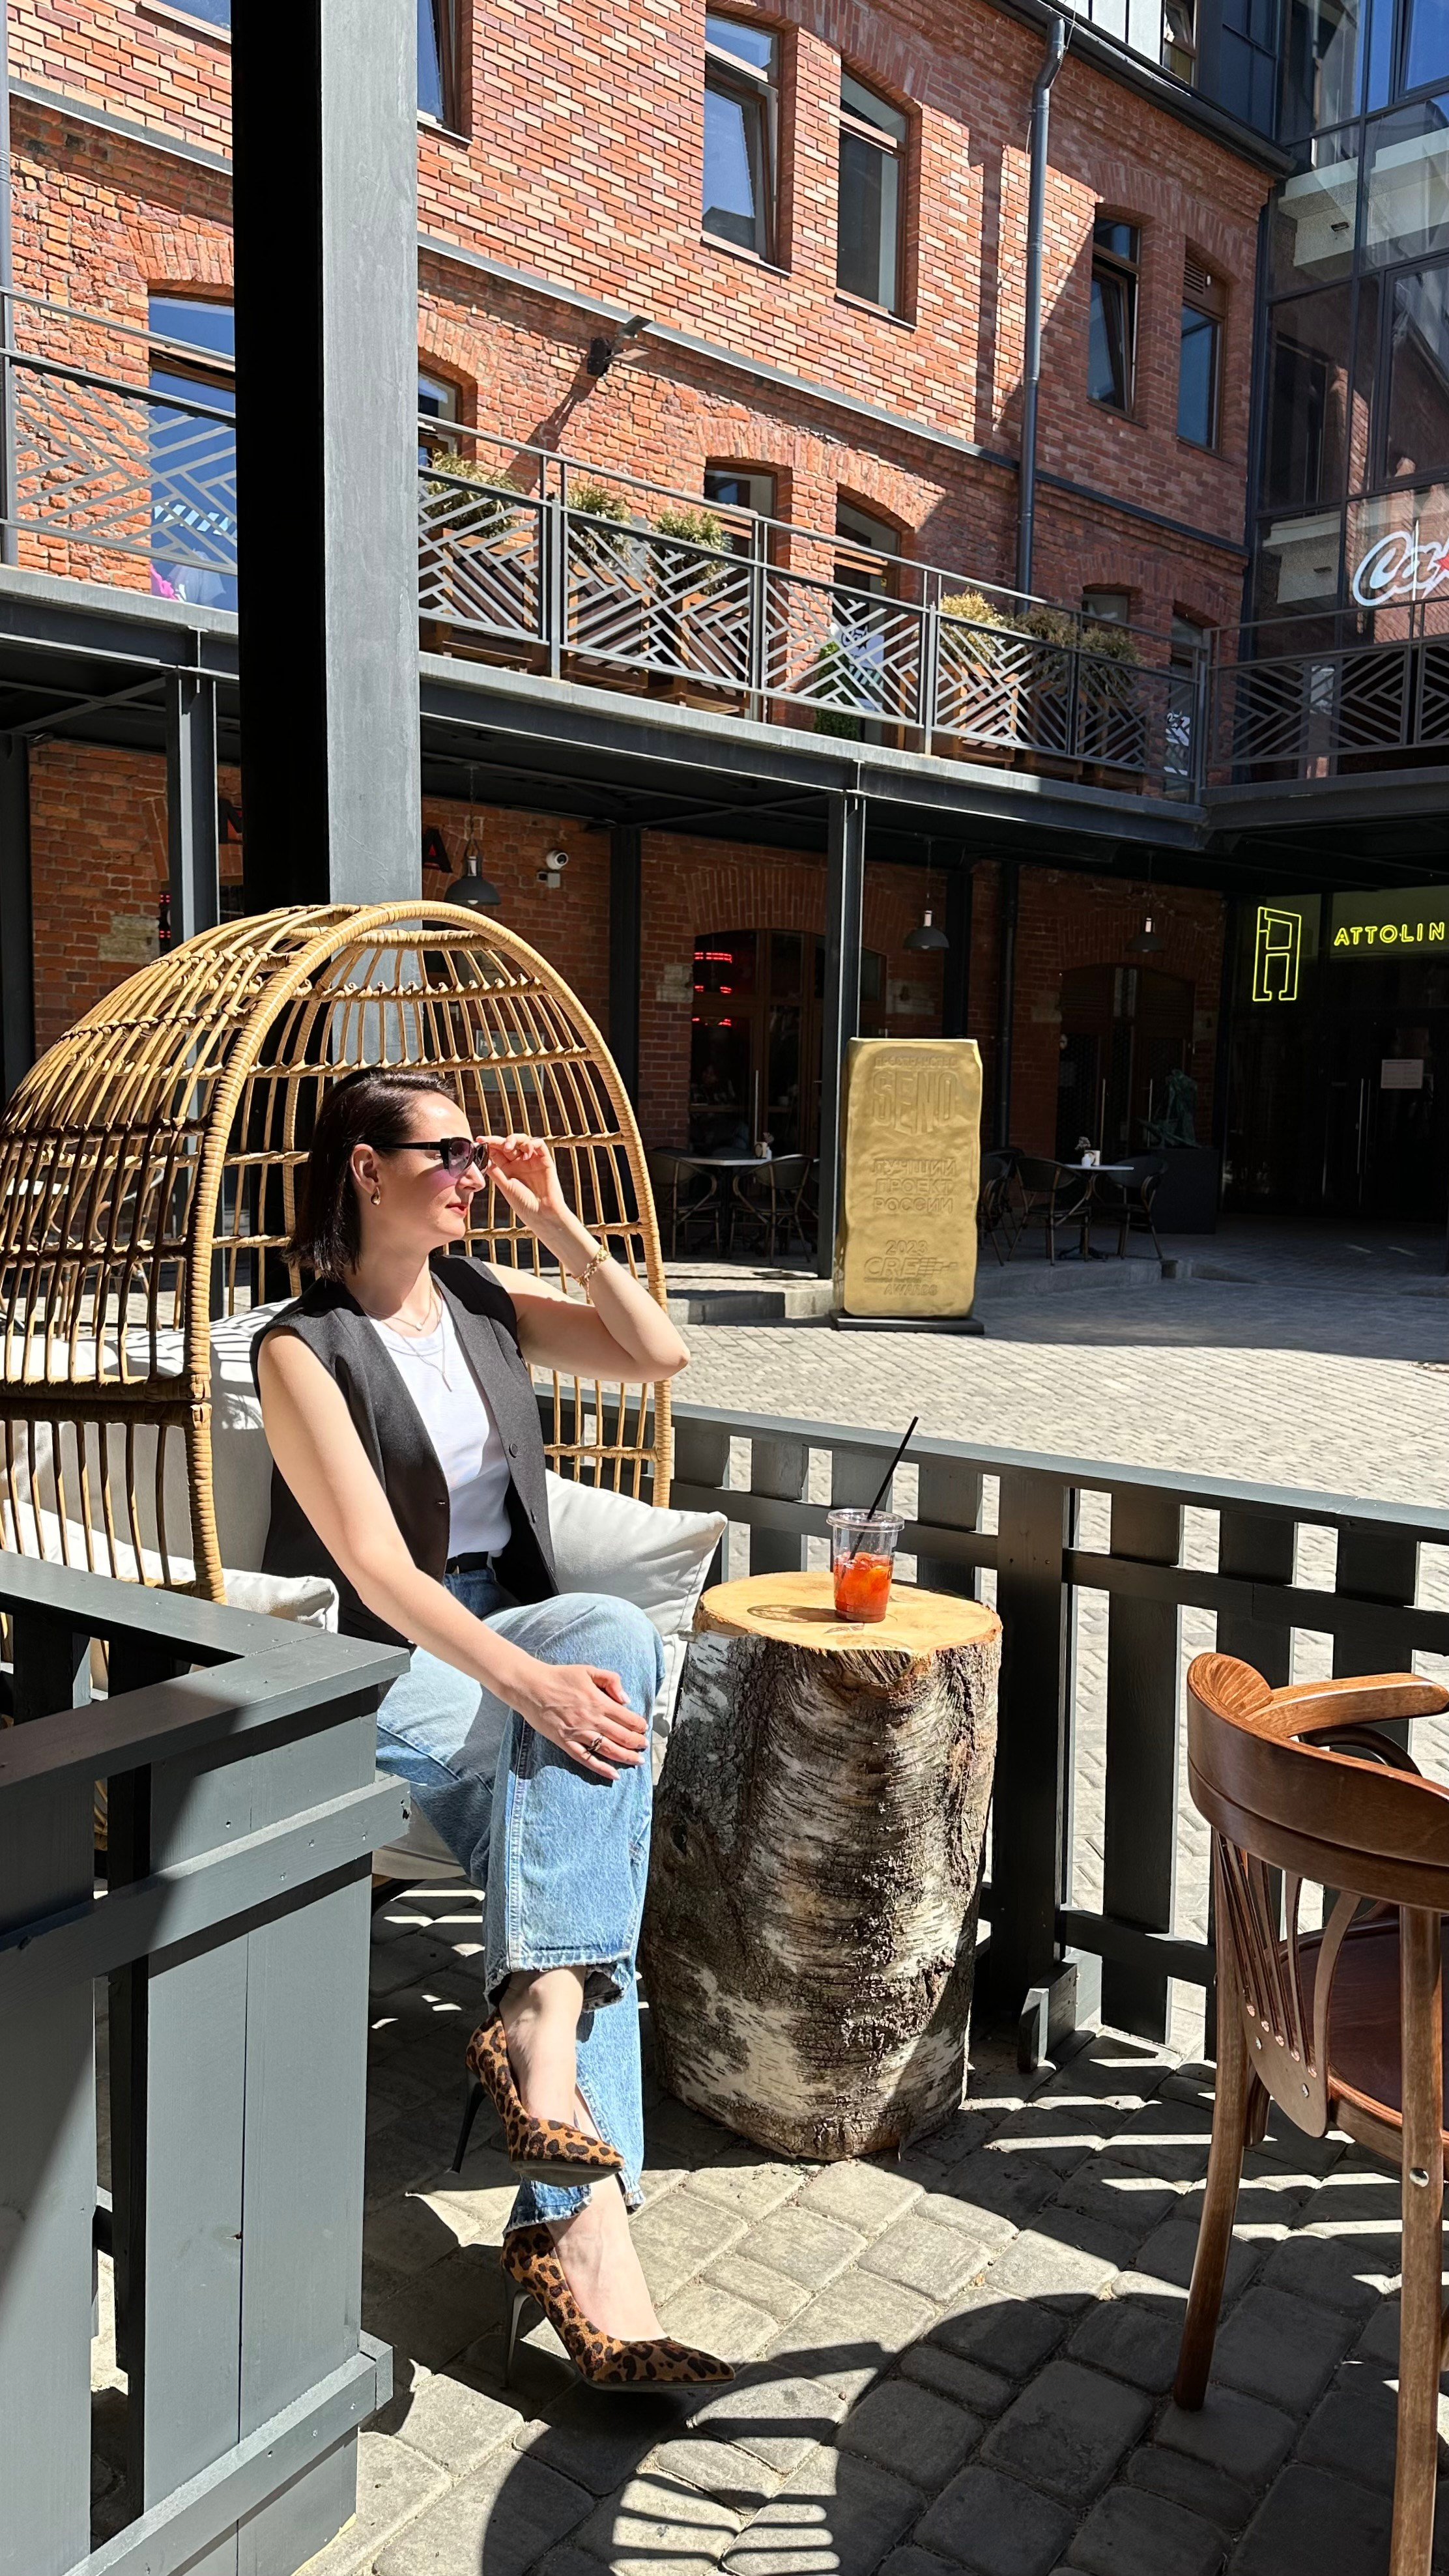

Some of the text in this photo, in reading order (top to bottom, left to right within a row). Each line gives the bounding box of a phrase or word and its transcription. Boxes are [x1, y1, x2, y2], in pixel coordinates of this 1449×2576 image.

[1334, 922, 1444, 946] ATTOLIN
[872, 1069, 958, 1135] SENO
[872, 1156, 956, 1177] ЛУЧШИЙ
[875, 1177, 953, 1195] ПРОЕКТ
[873, 1197, 953, 1213] РОССИИ
[885, 1239, 928, 1256] 2023
[864, 1256, 919, 1278] CRE
[883, 1283, 938, 1296] AWARDS
